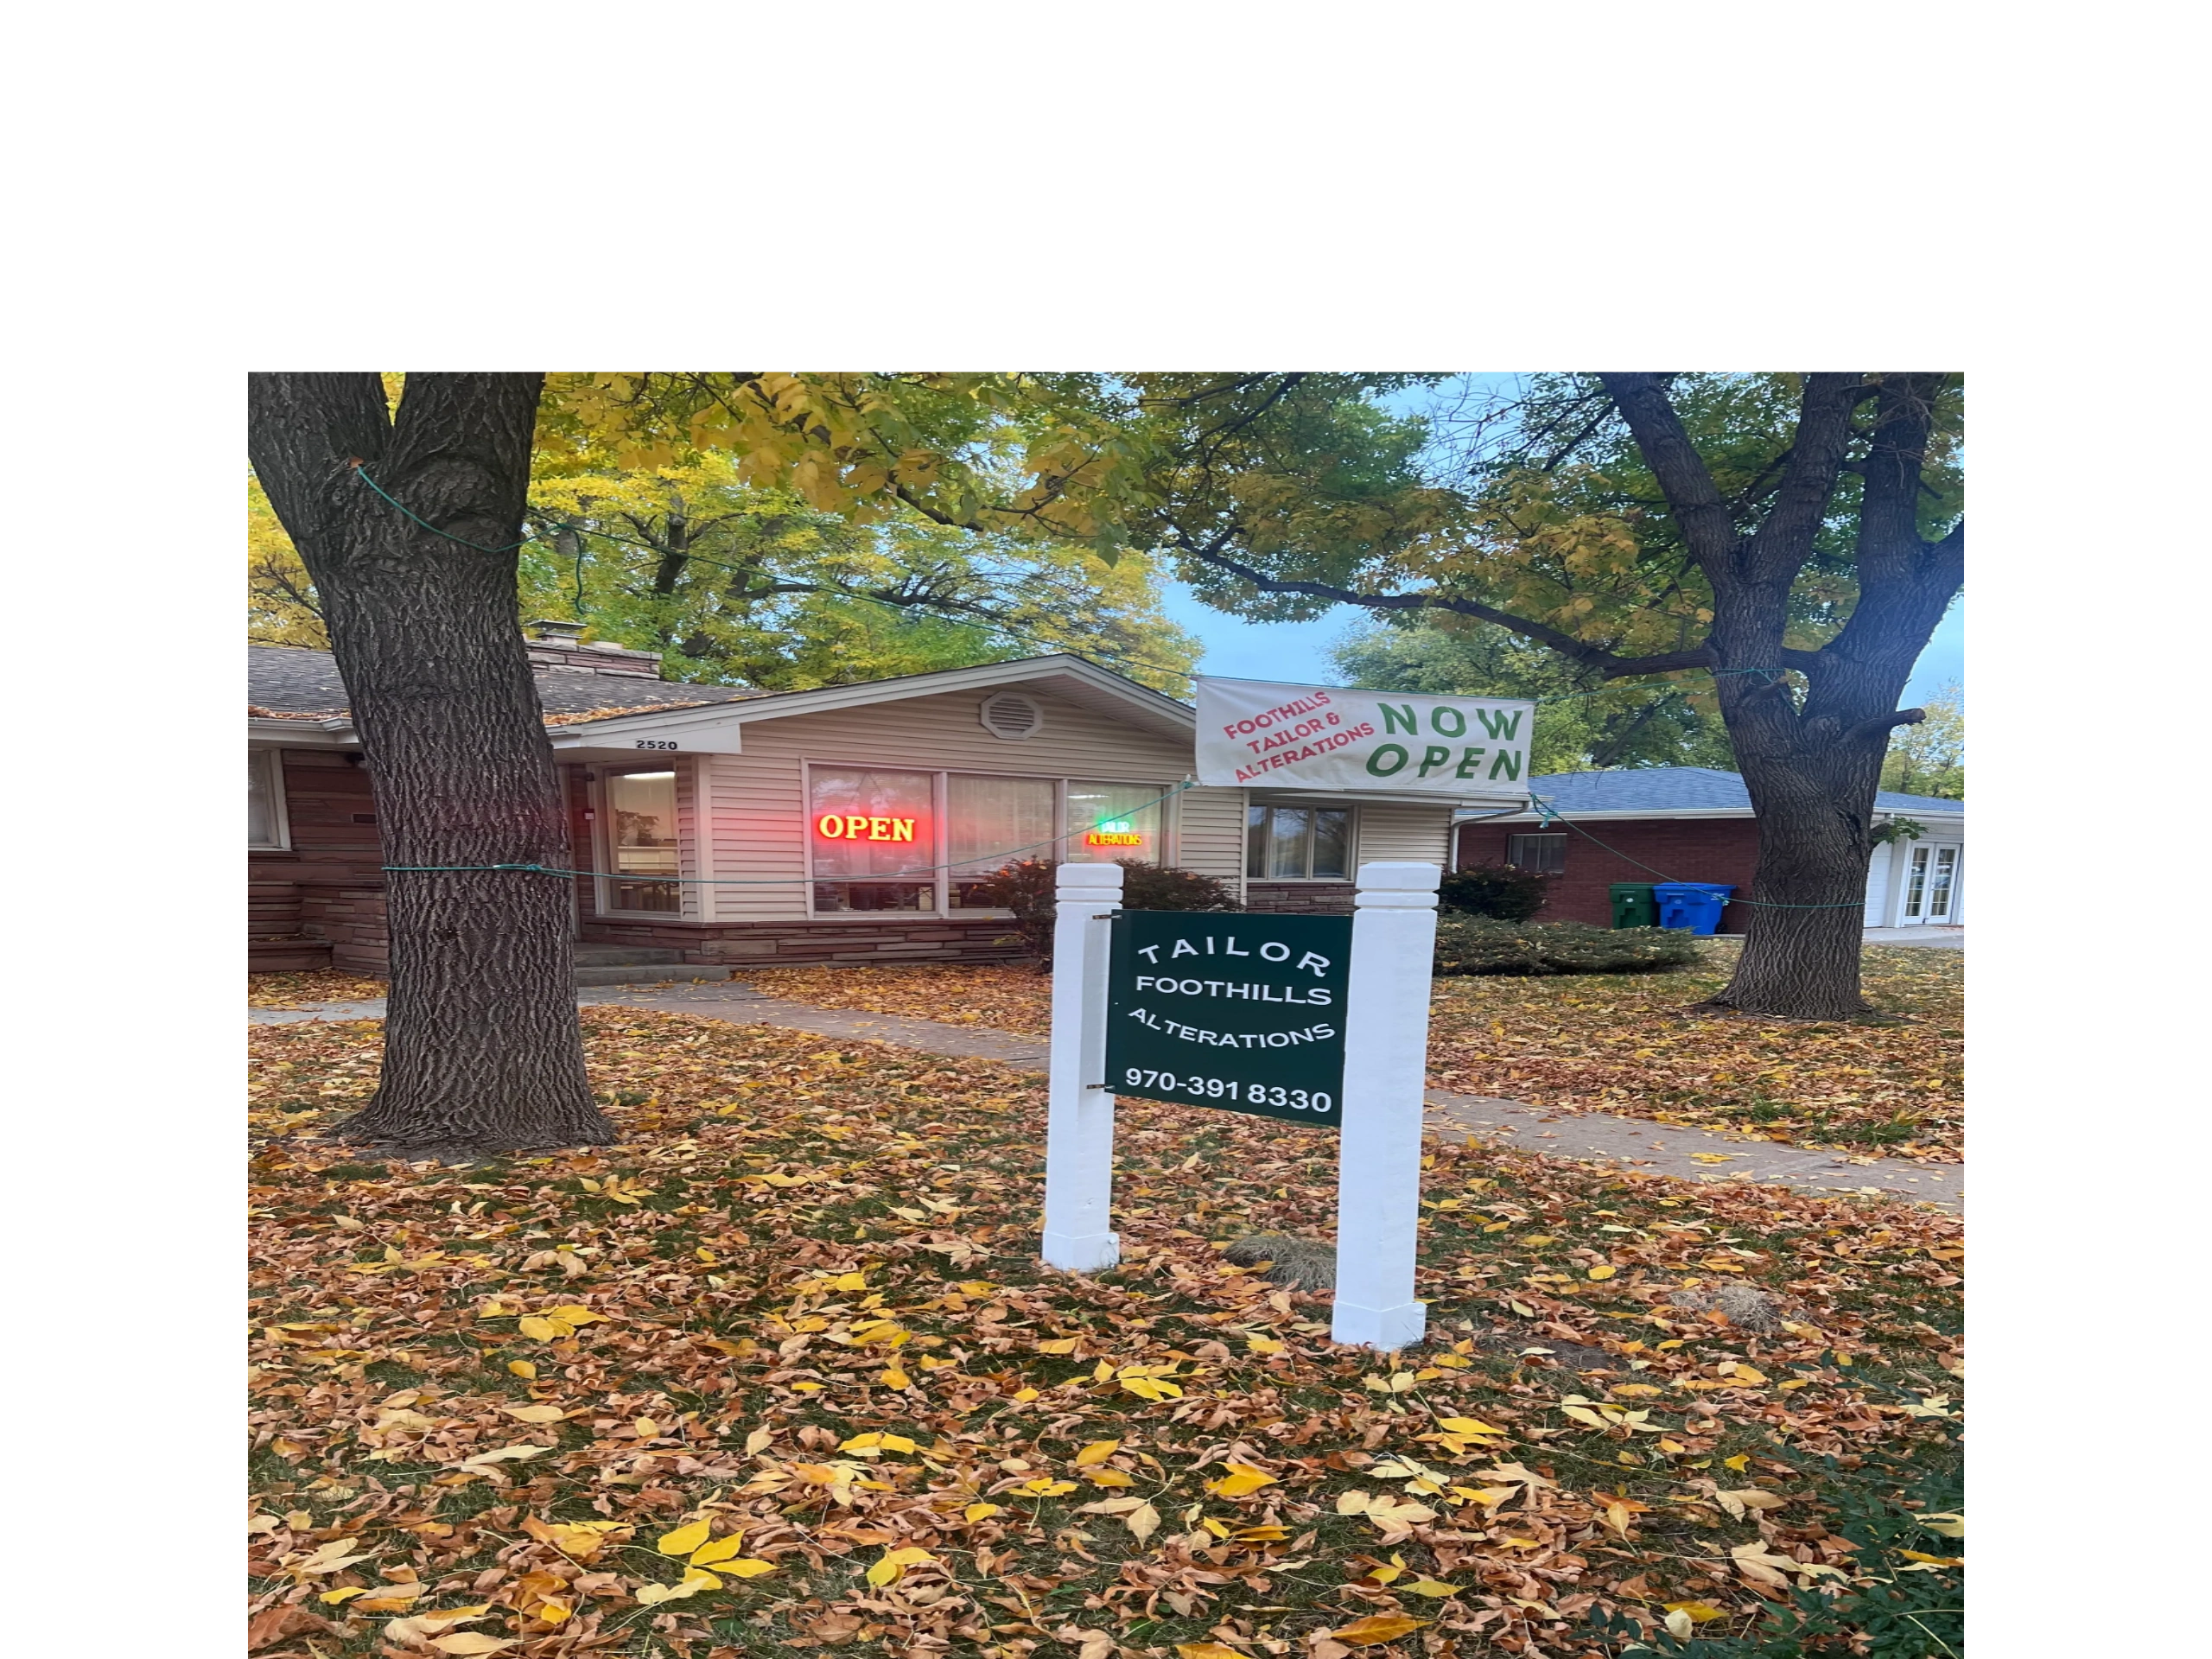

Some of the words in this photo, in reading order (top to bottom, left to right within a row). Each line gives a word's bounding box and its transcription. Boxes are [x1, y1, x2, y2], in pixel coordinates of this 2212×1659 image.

[1224, 691, 1332, 740] FOOTHILLS
[1247, 722, 1325, 753] TAILOR
[1326, 711, 1340, 726] &
[1377, 702, 1523, 741] NOW
[636, 740, 678, 751] 2520
[1235, 722, 1375, 783] ALTERATIONS
[1366, 743, 1522, 782] OPEN
[819, 814, 915, 842] OPEN
[1089, 834, 1142, 845] ALTERATIONS
[1138, 936, 1331, 977] TAILOR
[1136, 976, 1332, 1006] FOOTHILLS
[1128, 1007, 1336, 1048] ALTERATIONS
[1126, 1068, 1238, 1100] 970-391
[1247, 1084, 1332, 1113] 8330
